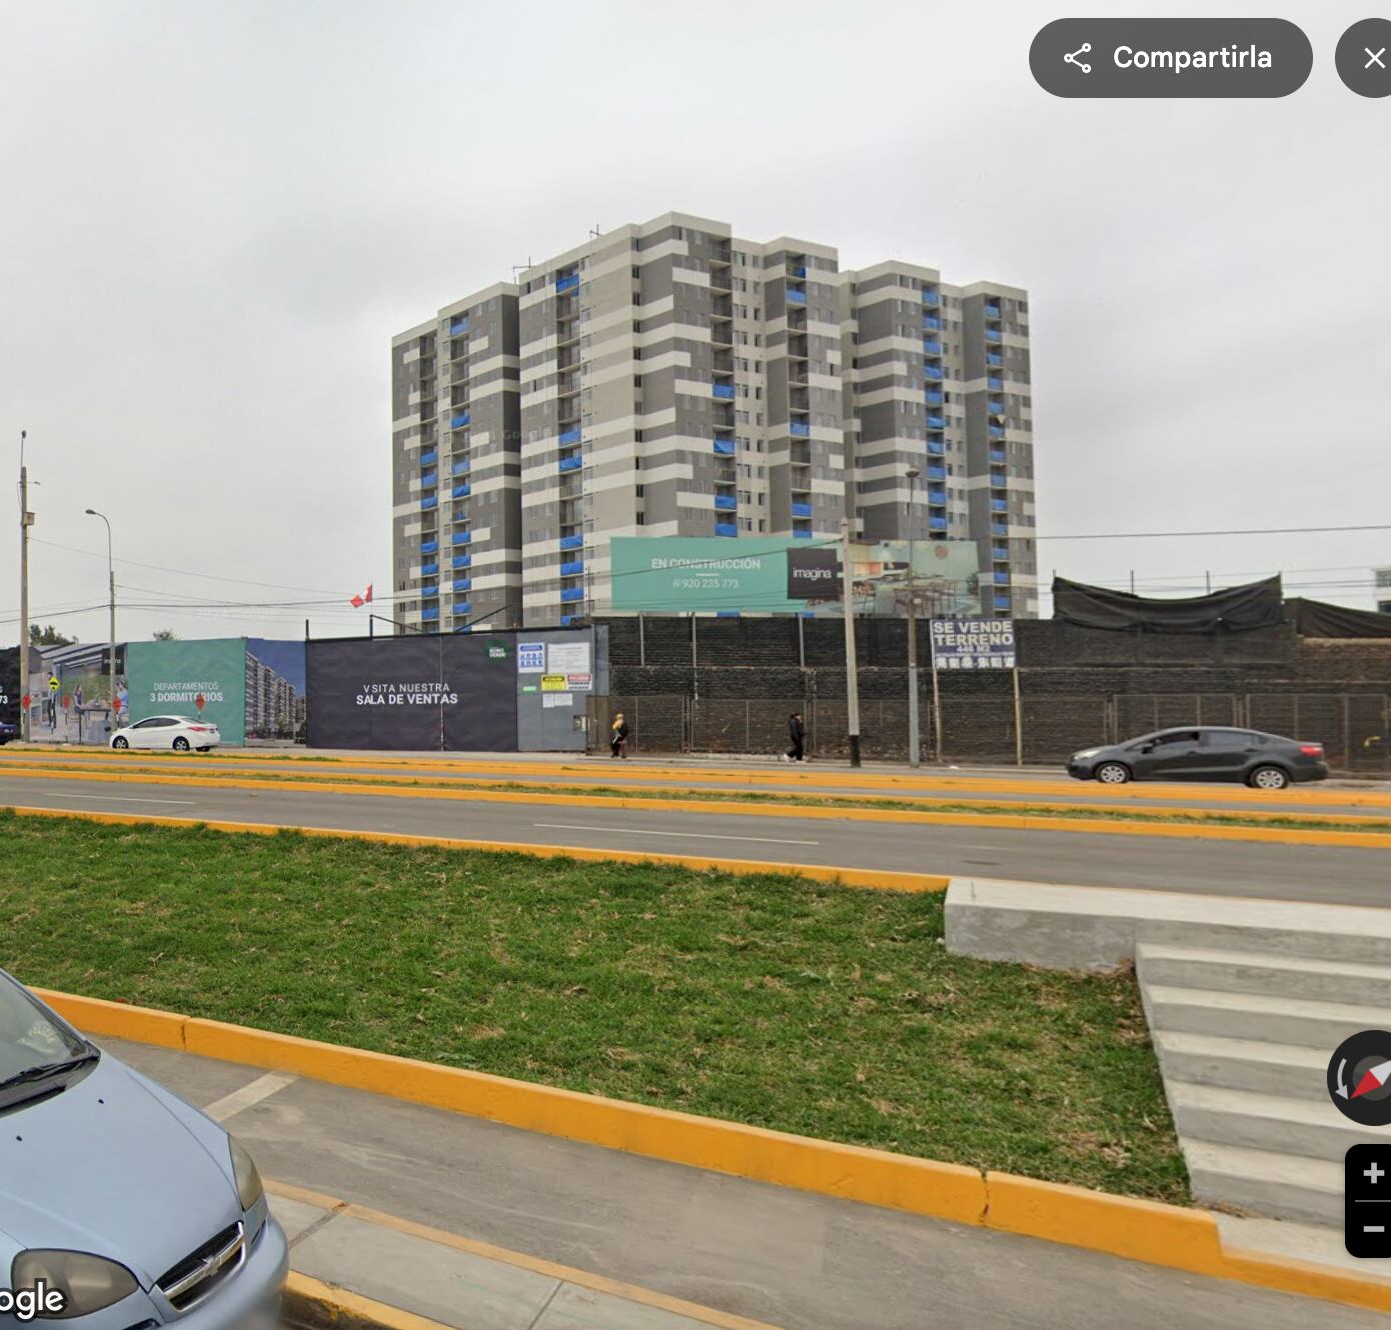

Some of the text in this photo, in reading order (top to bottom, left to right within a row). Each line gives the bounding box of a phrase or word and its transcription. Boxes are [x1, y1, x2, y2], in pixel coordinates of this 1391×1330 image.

[651, 556, 761, 570] EN CONSTRUCCIÓN
[793, 567, 832, 580] imagina
[682, 578, 700, 588] 920
[702, 578, 719, 588] 235
[934, 620, 1012, 633] SE VENDE
[935, 633, 1013, 645] TERRENO
[153, 682, 219, 691] DEPARTAMENTOS
[399, 683, 449, 693] NUESTRA
[149, 693, 156, 702] 3
[356, 694, 458, 705] SALA DE VENTAS
